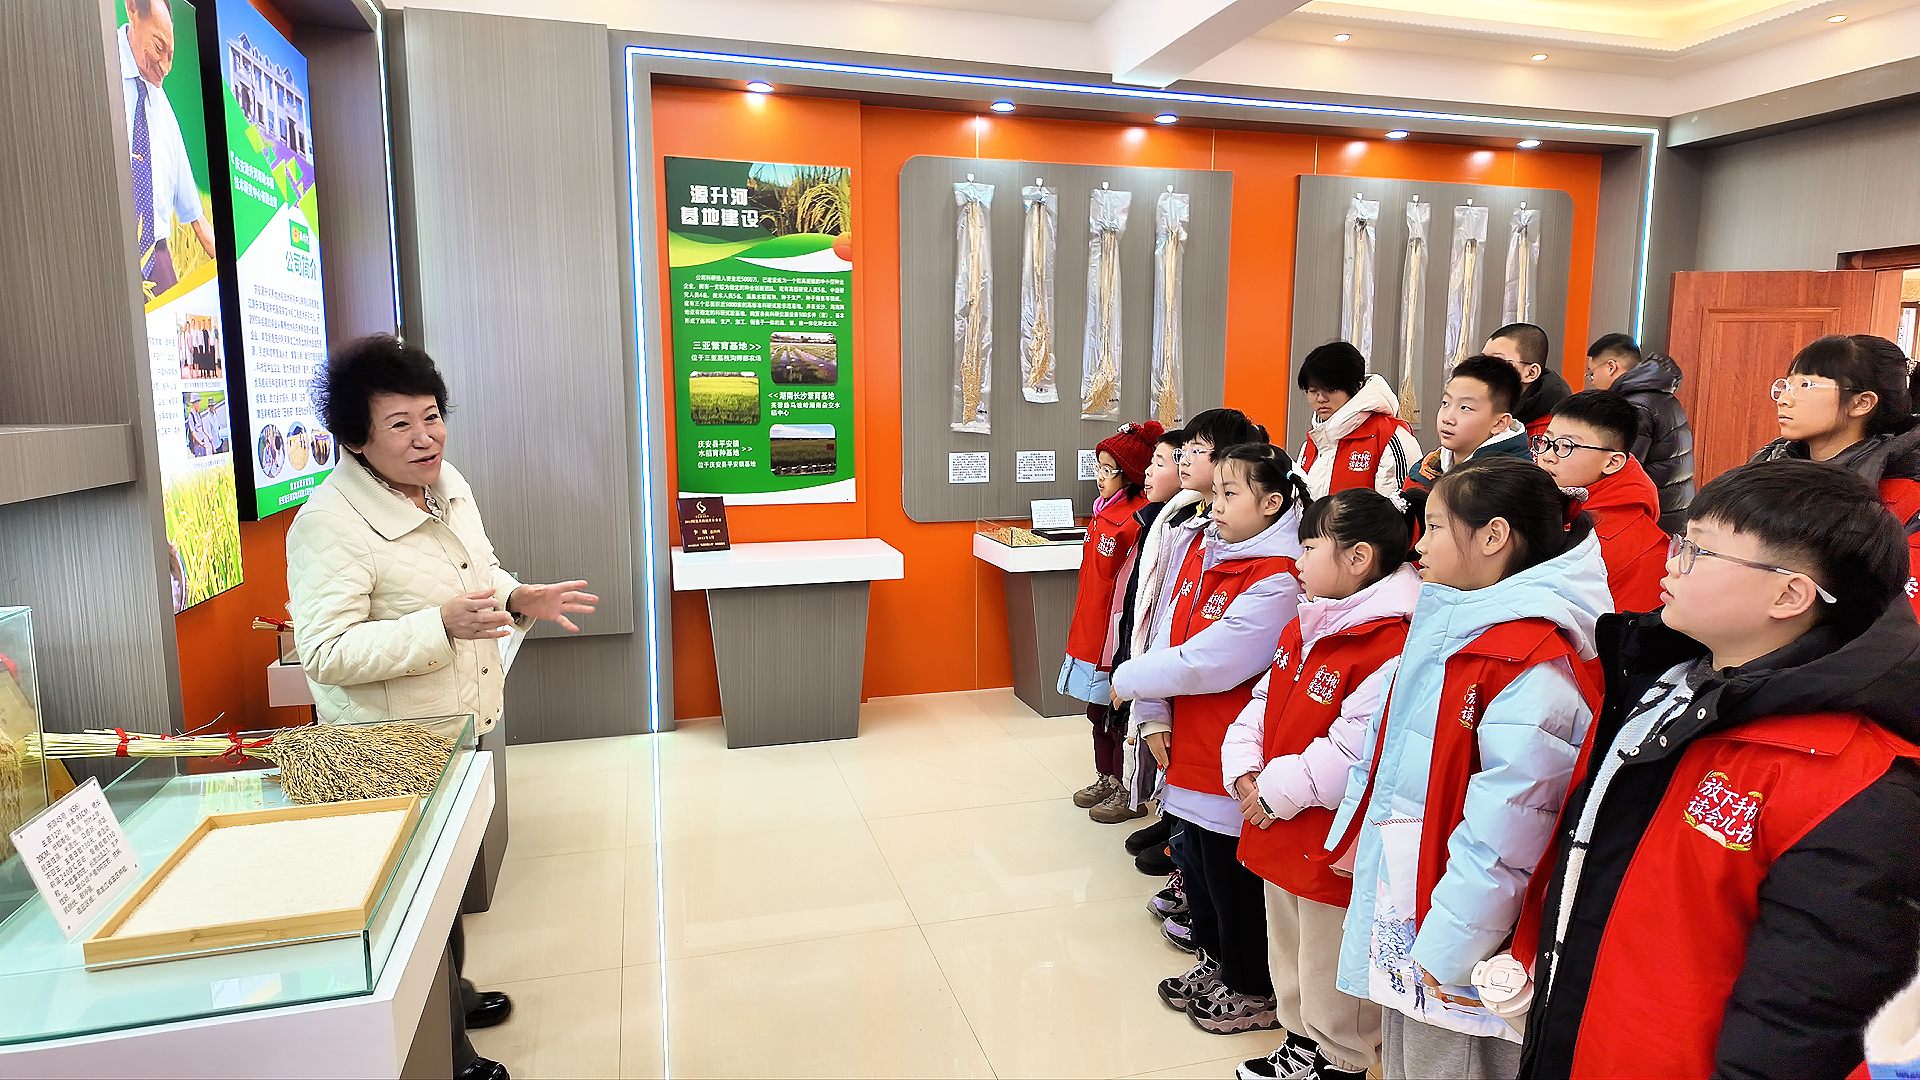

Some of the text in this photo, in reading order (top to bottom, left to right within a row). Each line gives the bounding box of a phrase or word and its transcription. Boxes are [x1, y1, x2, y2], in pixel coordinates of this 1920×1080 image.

[689, 184, 749, 206] 源升河
[680, 206, 760, 229] 基地建设
[286, 250, 317, 280] 公司简介
[692, 341, 748, 351] 三亚繁育基地
[779, 391, 836, 401] 湖南长沙繁育基地
[698, 449, 740, 457] 水稻育种基地
[1688, 796, 1753, 843] 读会儿书
